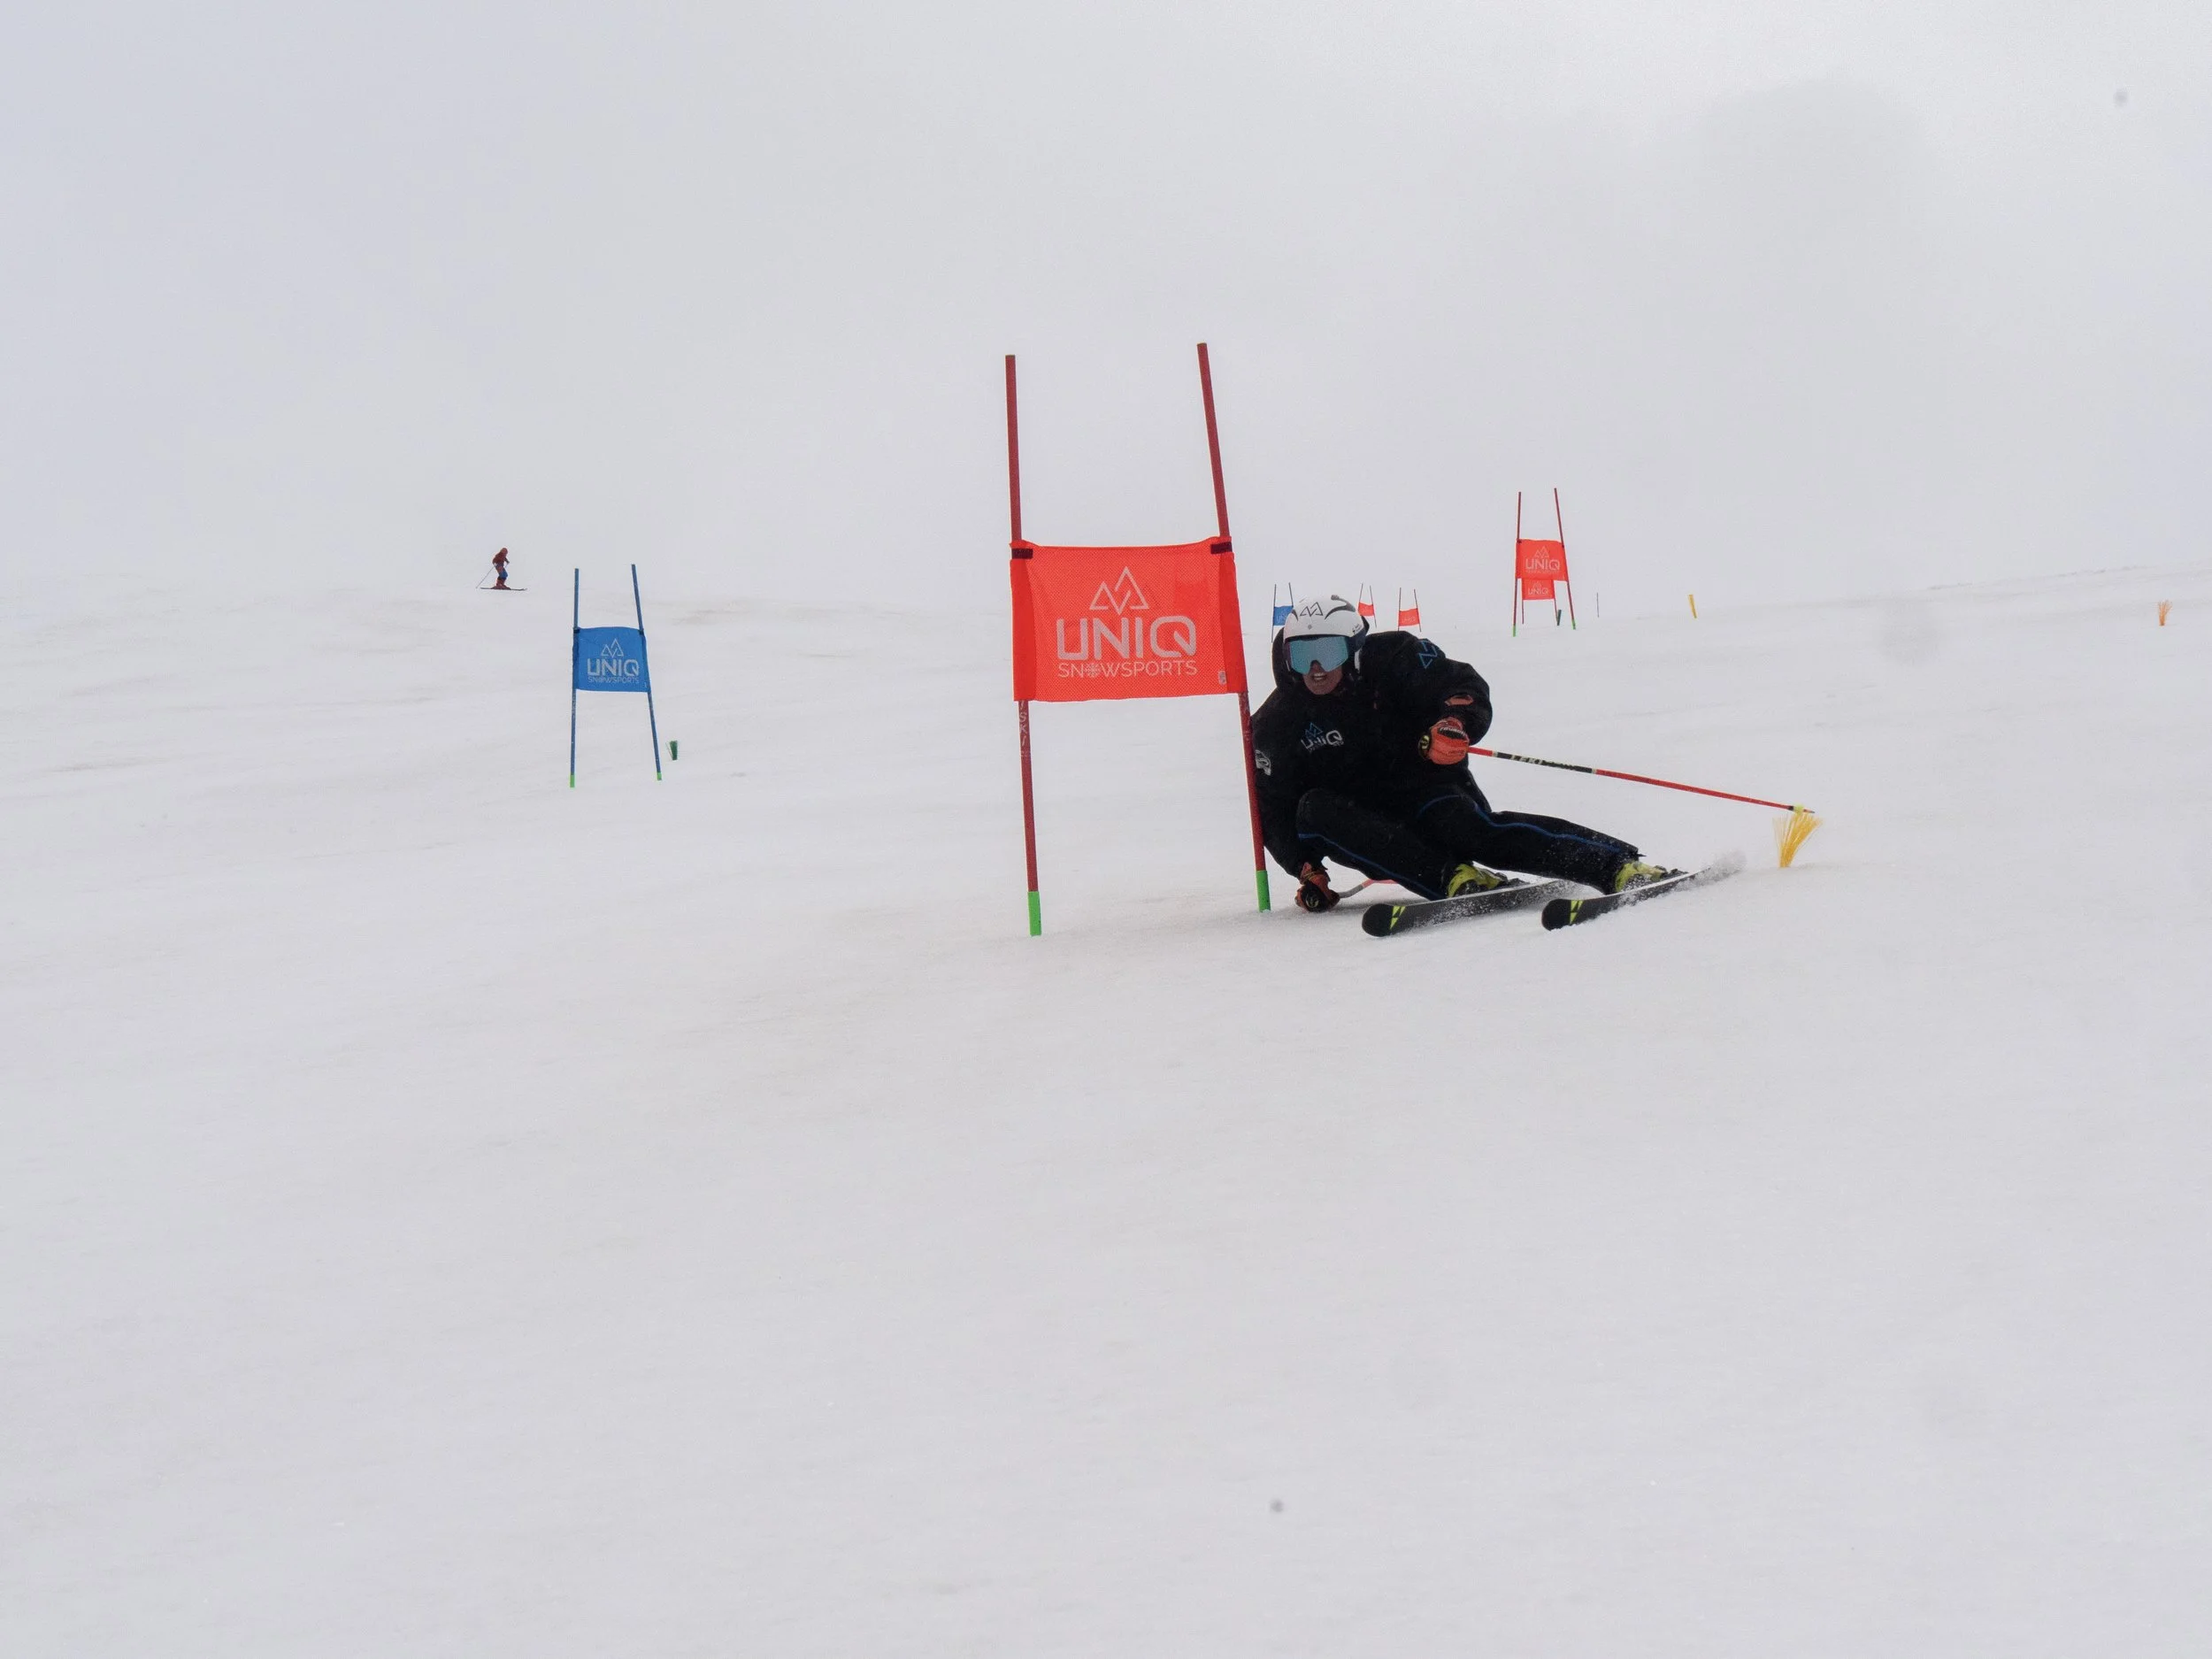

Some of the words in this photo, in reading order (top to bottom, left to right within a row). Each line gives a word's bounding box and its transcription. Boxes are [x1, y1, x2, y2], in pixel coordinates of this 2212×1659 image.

[1525, 558, 1560, 571] UNIQ
[1056, 615, 1197, 660] UNIQ
[587, 657, 640, 676] UNIQ
